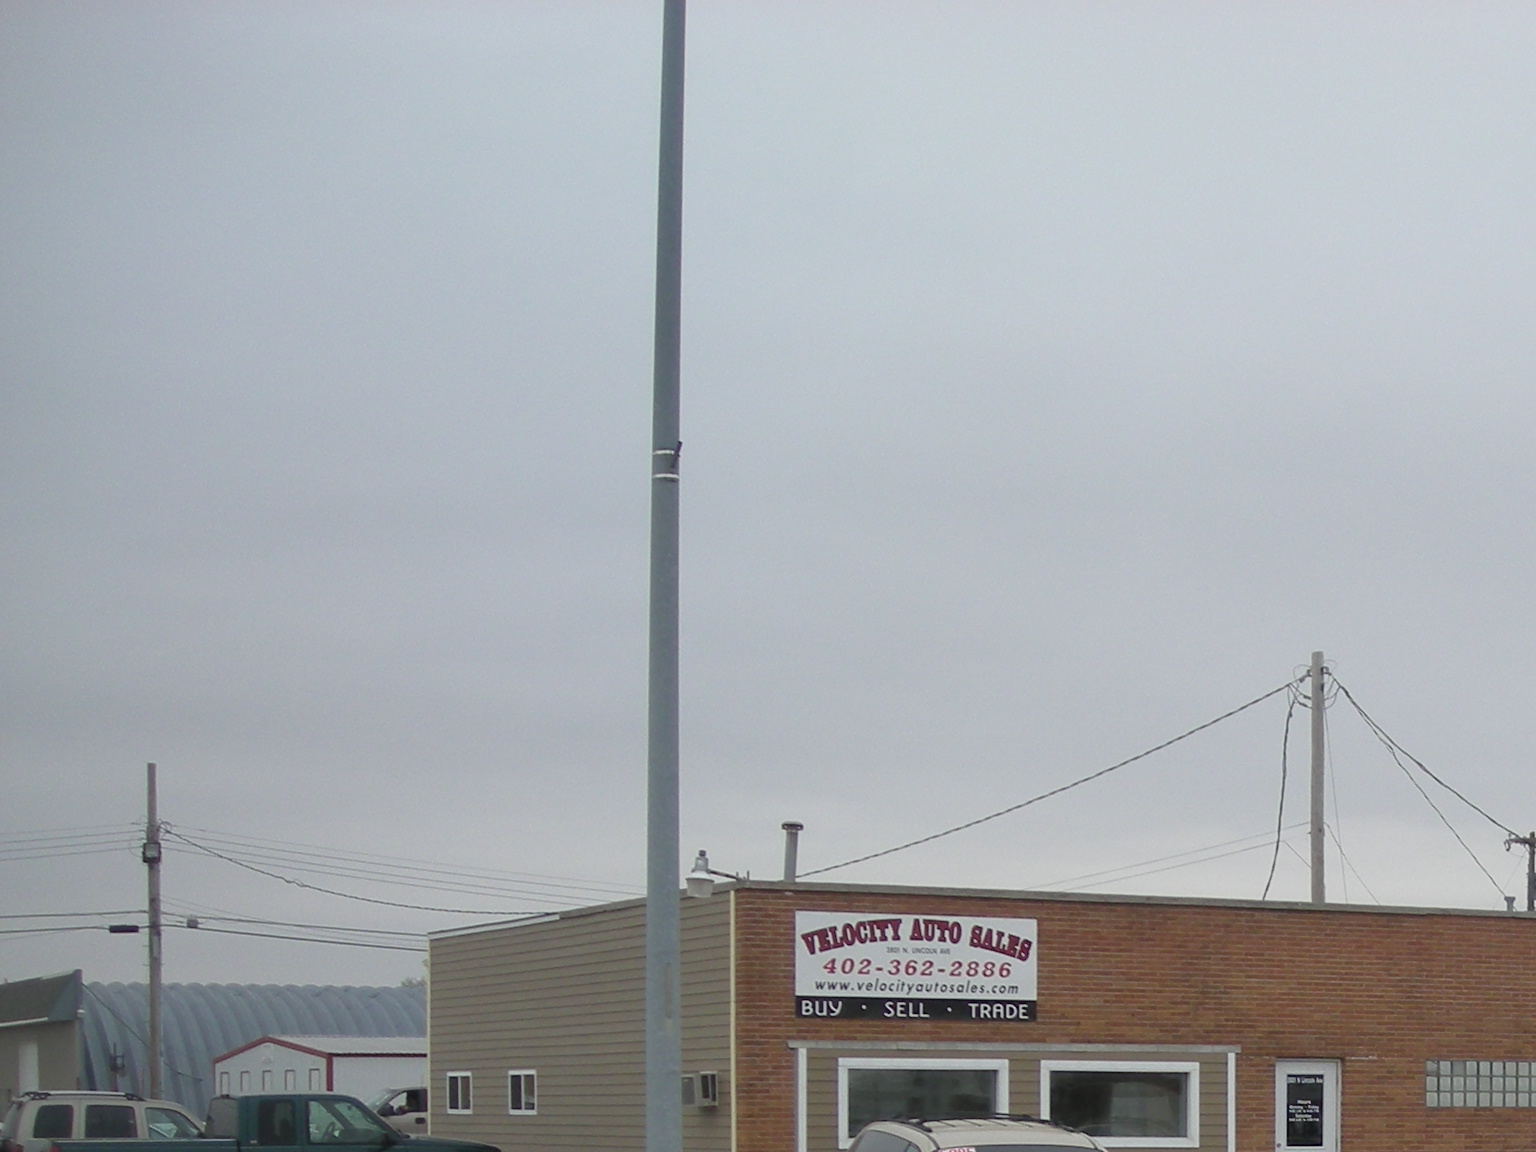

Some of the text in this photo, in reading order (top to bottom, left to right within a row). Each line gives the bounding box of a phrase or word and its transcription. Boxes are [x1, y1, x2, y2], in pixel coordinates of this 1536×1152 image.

[800, 918, 1033, 962] VELOCITY AUTO SALES
[823, 957, 1012, 978] 402-362-2886
[815, 978, 1019, 995] www.velocityautosales.com
[801, 1000, 1030, 1019] BUY SELL TRADE
